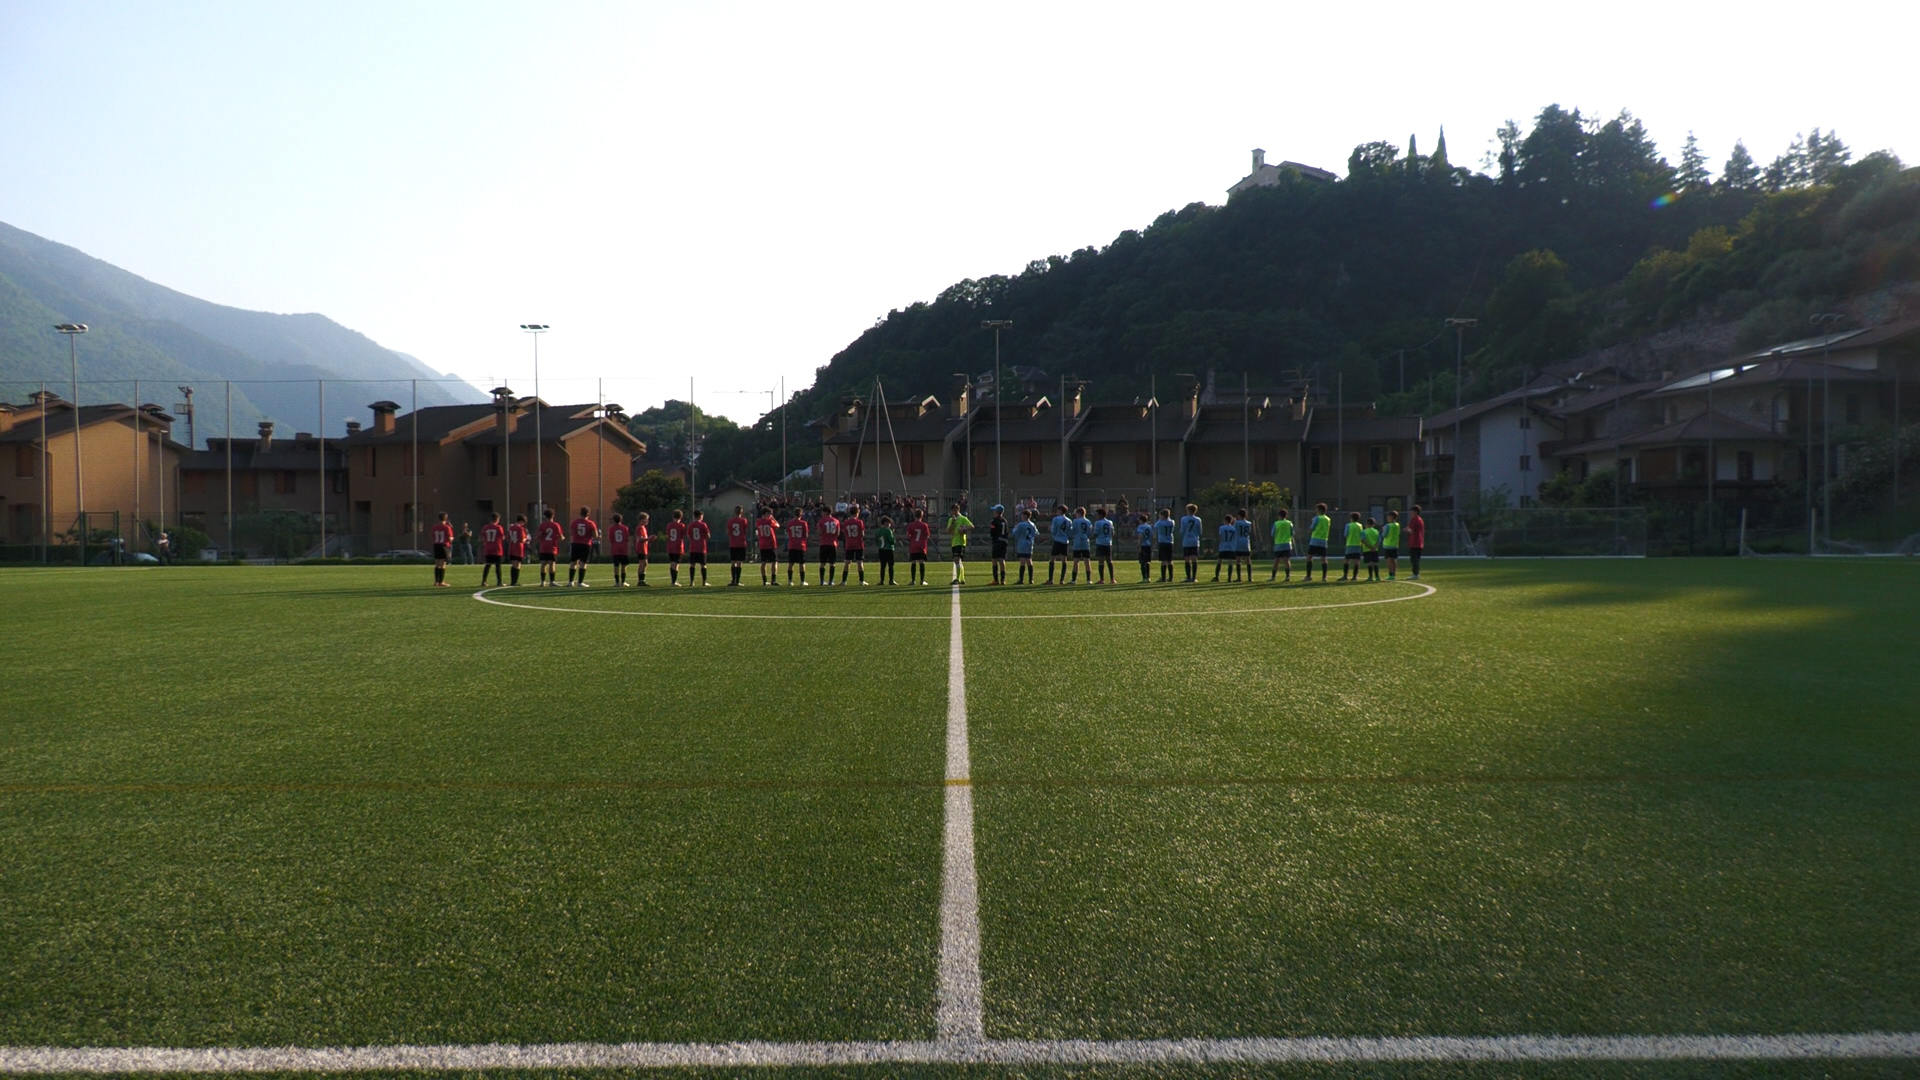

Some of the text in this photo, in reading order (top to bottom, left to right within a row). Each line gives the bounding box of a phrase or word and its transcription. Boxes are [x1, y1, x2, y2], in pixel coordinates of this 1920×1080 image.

[578, 524, 586, 536] 5
[732, 523, 740, 536] 3
[759, 524, 771, 537] 10
[790, 525, 802, 538] 15
[846, 525, 858, 538] 13
[1001, 522, 1006, 534] 1
[1060, 520, 1066, 532] 4
[1081, 522, 1087, 534] 9
[1103, 523, 1110, 535] 6
[1188, 520, 1195, 532] 7
[1239, 525, 1249, 537] 18
[434, 530, 445, 543] 11
[486, 529, 497, 542] 17
[546, 528, 553, 541] 2
[615, 530, 623, 542] 6
[670, 529, 677, 542] 9
[693, 528, 701, 540] 8
[915, 529, 922, 542] 7
[1224, 530, 1234, 542] 17
[879, 536, 885, 548] 1
